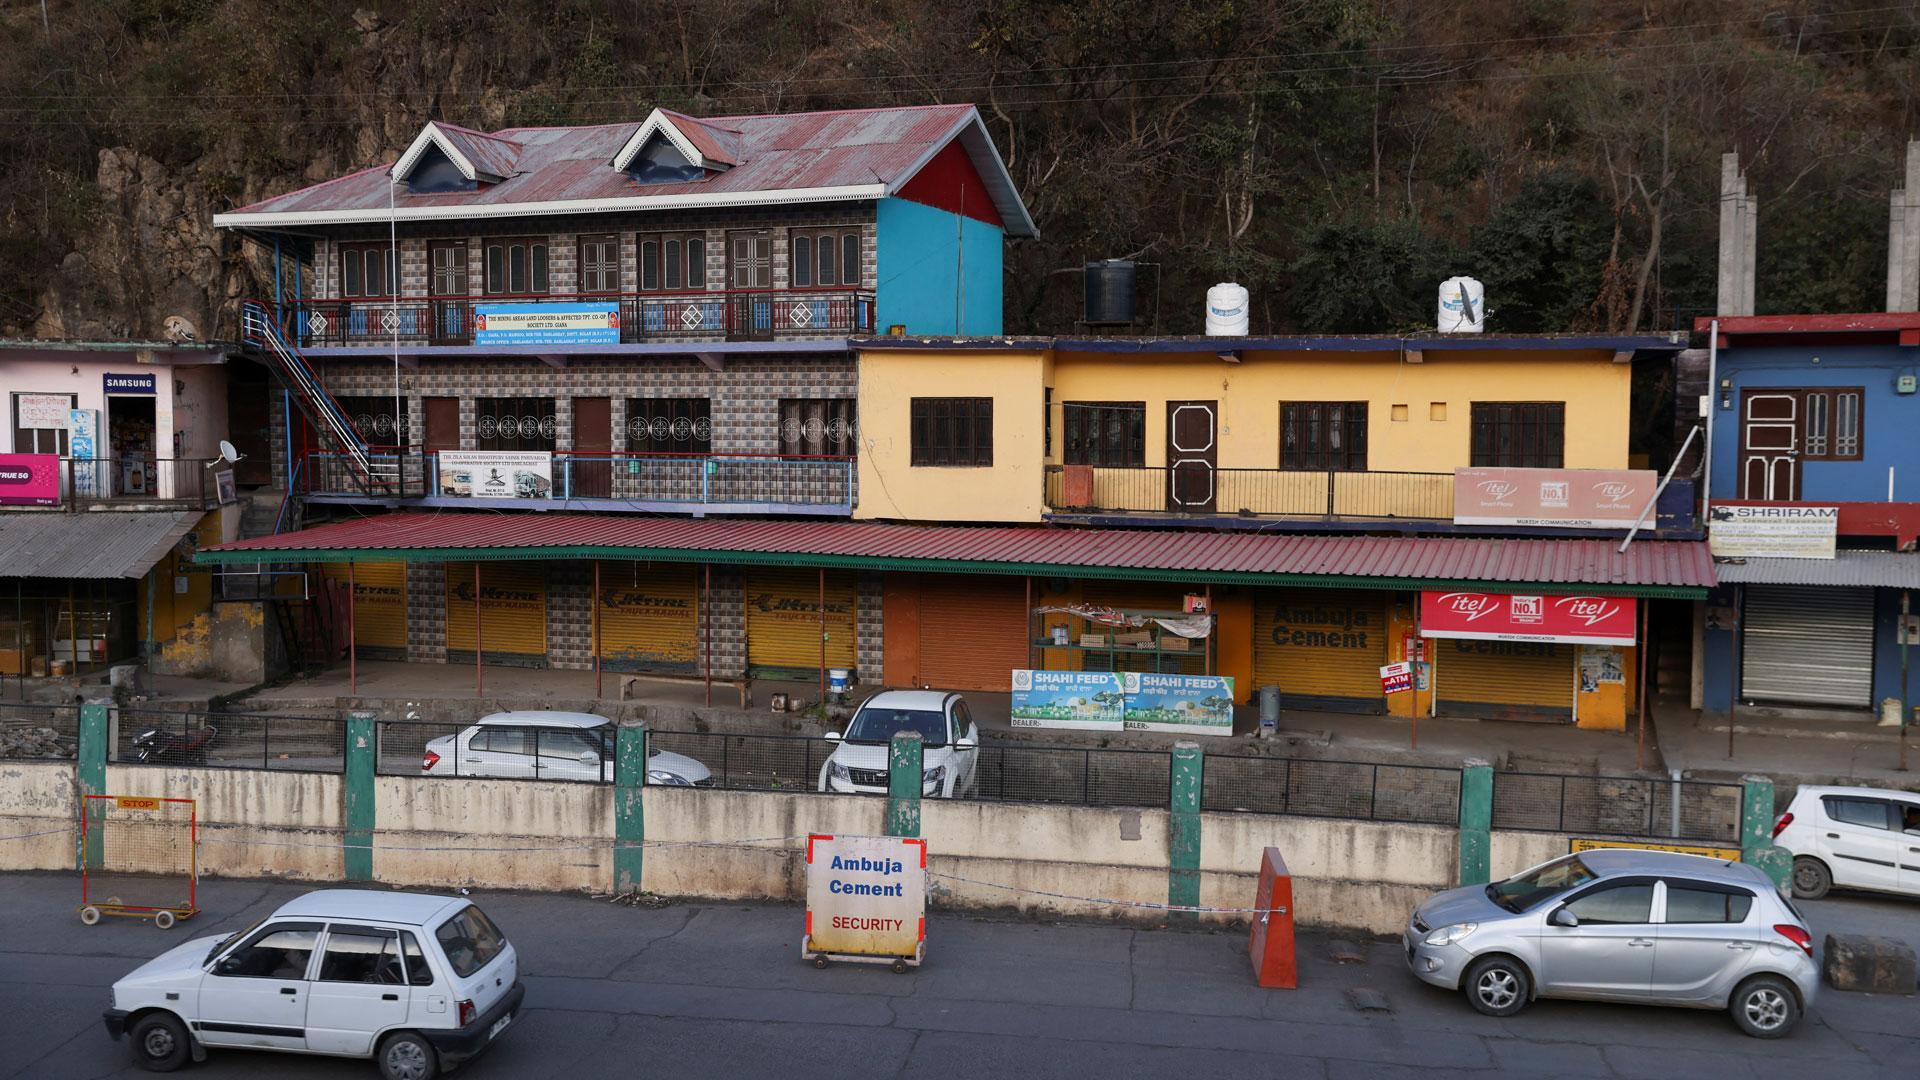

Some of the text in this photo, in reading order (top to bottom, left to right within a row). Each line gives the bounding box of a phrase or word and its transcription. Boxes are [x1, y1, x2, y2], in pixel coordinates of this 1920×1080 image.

[107, 378, 152, 388] SAMSUNG
[1543, 485, 1567, 498] NO.1
[1737, 508, 1836, 517] SHRIRAM
[1514, 598, 1540, 614] NO.1
[1272, 606, 1368, 631] Ambuja
[1272, 626, 1367, 648] Cement
[1035, 674, 1108, 684] SHAHI FEED
[1143, 677, 1217, 688] SHAHI FEED
[1390, 675, 1408, 683] ATM
[831, 856, 902, 875] Ambuja
[830, 880, 902, 896] Cement
[832, 917, 903, 931] SECURITY
